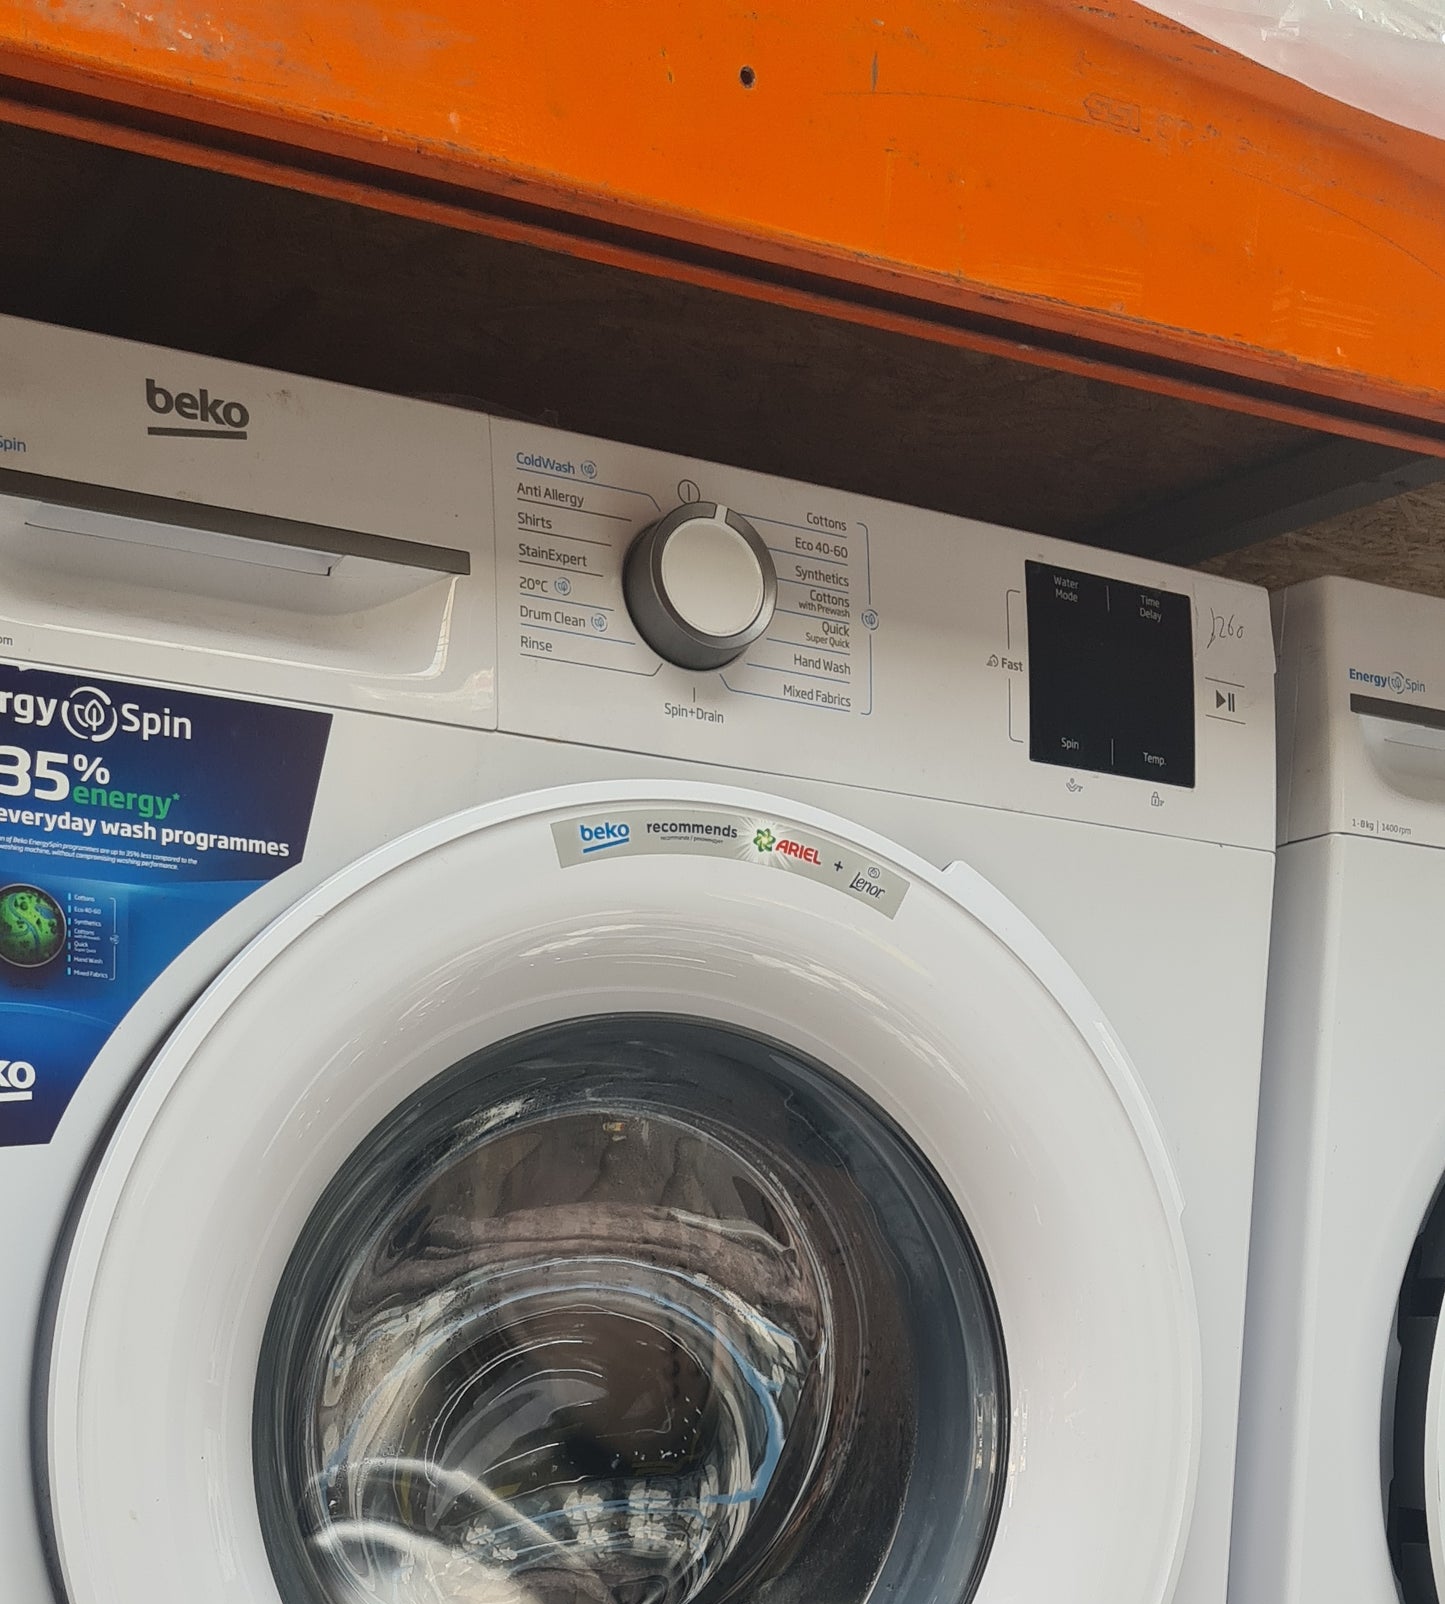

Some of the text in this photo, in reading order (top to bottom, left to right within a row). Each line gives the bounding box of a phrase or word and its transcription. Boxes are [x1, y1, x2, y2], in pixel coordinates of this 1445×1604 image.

[145, 378, 250, 428] beko
[516, 452, 575, 474] ColdWash
[517, 482, 584, 508] Anti Allergy
[517, 512, 552, 529] Shirts
[807, 512, 847, 531] Cottons
[519, 544, 587, 567] StainExpert
[795, 537, 848, 558] Eco 40-60
[520, 576, 548, 592] 20°C
[795, 565, 849, 587] Synthetics
[1053, 575, 1079, 589] Water
[810, 589, 850, 608] Cottons
[1055, 589, 1078, 602] Mode
[1140, 595, 1160, 608] Time
[520, 605, 586, 627] Drum Clean
[799, 602, 850, 618] with Prewash
[1140, 608, 1162, 623] Delay
[822, 621, 850, 637] Quick
[520, 635, 552, 652] Rinse
[805, 632, 850, 648] Super Quick
[794, 654, 851, 675] Hand Wash
[1002, 658, 1023, 672] Fast
[1350, 668, 1425, 693] Energy Spin
[783, 684, 851, 707] Mixed Fabrics
[122, 704, 192, 740] Spin
[664, 702, 724, 723] Spin+Drain
[1061, 737, 1079, 750] Spin
[1143, 752, 1167, 767] Temp.
[100, 820, 156, 841] wash
[161, 827, 290, 857] programmes
[579, 822, 630, 842] beko
[646, 822, 738, 838] recommends
[776, 839, 821, 866] ARIEL
[849, 872, 886, 898] Lenor
